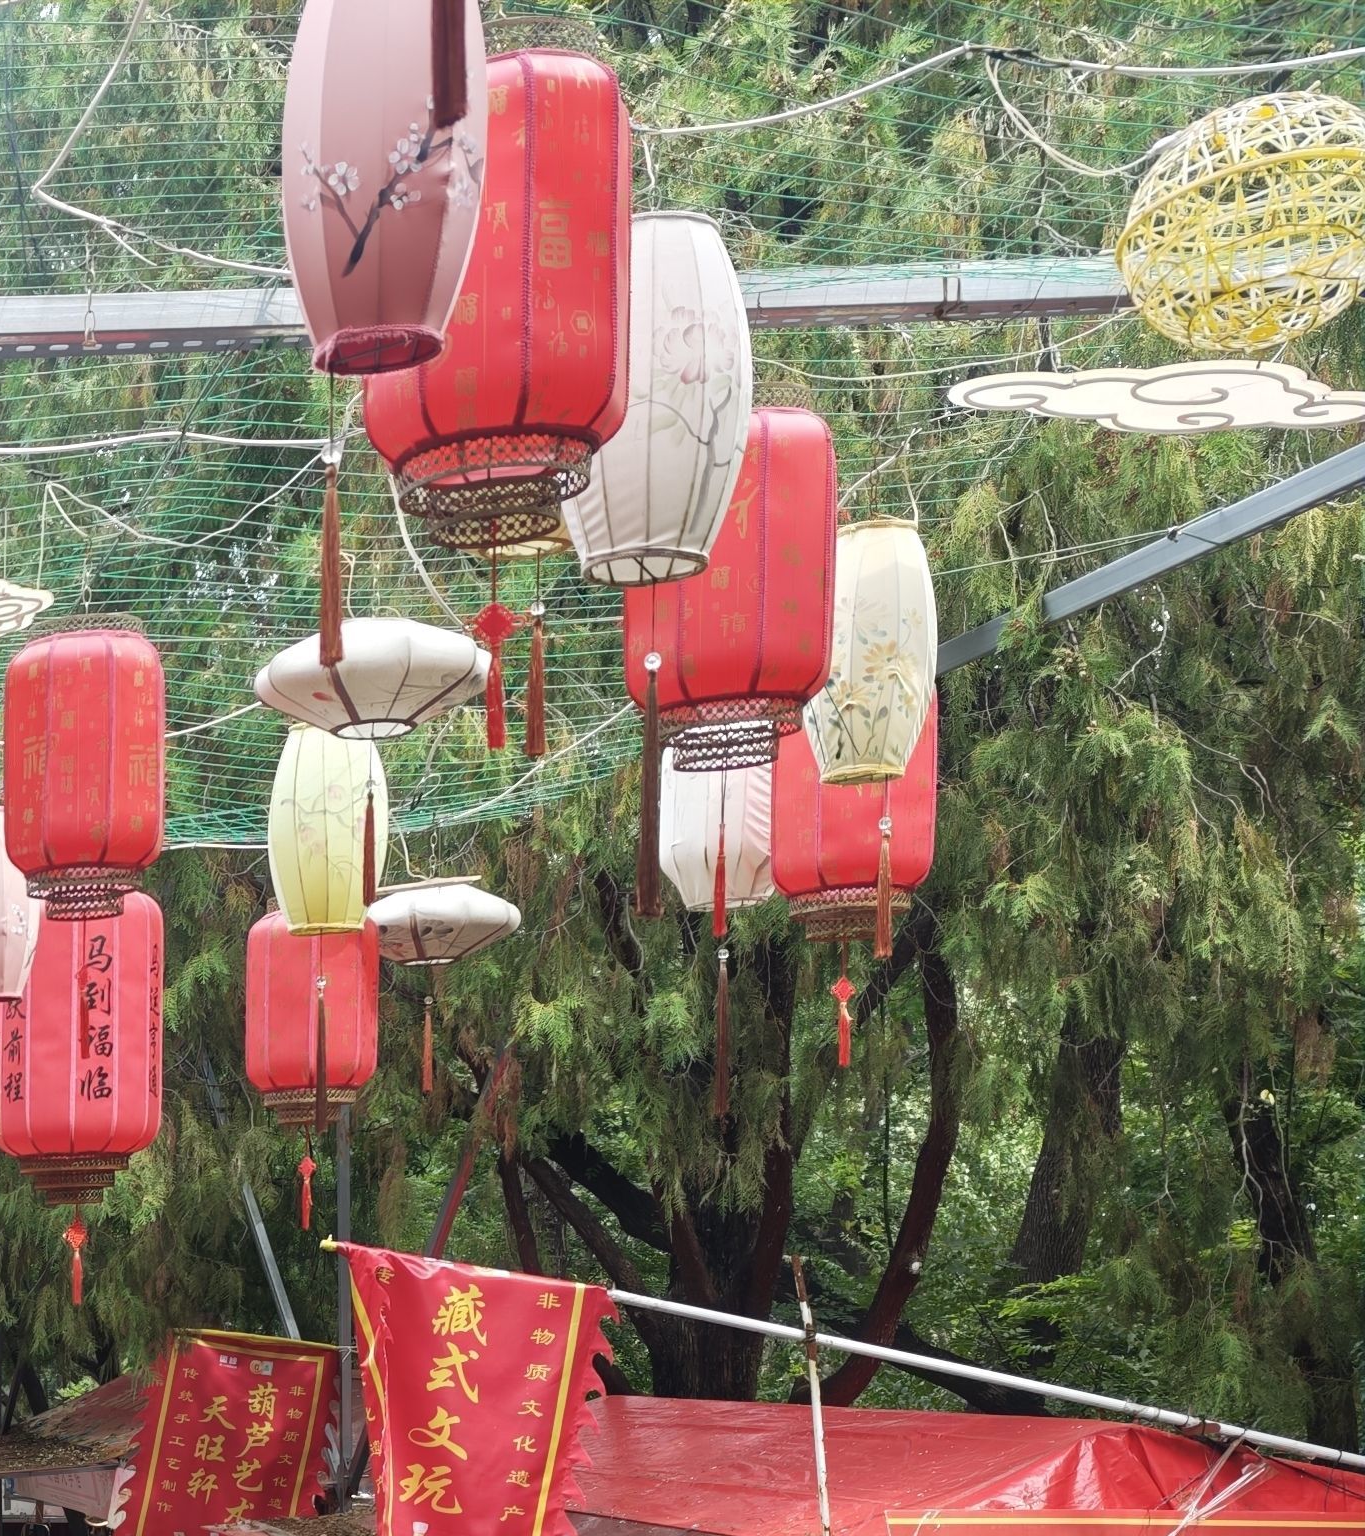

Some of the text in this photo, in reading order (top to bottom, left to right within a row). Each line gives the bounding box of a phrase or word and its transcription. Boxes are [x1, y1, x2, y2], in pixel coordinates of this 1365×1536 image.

[80, 934, 114, 1102] 马到福临
[156, 1366, 200, 1513] 传统手工艺制作
[186, 1395, 237, 1505] 天旺轩
[223, 1381, 280, 1523] 葫芦艺术
[399, 1284, 488, 1515] 藏式文玩
[499, 1292, 563, 1523] 非物质文化遗产
